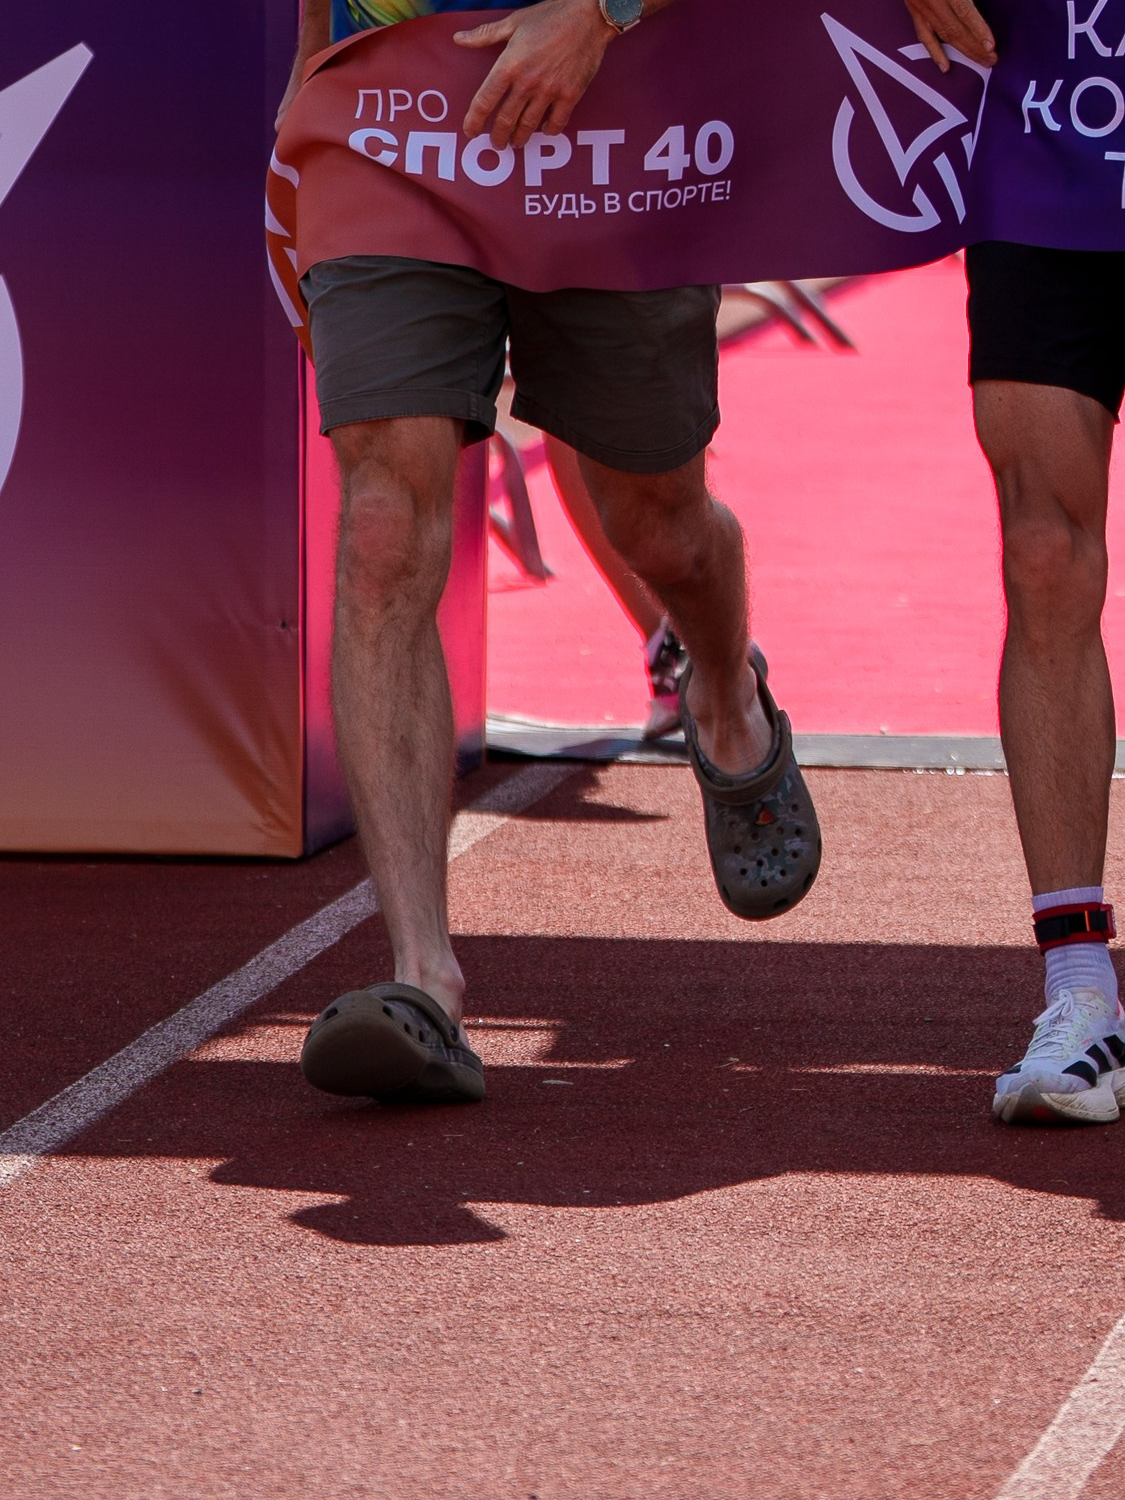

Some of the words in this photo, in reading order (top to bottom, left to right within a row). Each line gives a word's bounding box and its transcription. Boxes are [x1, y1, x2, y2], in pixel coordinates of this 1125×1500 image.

[354, 88, 449, 123] ПРО
[348, 127, 626, 188] СПОРТ
[643, 120, 735, 182] 40
[524, 193, 597, 219] БУДЬ
[603, 192, 621, 214] В
[628, 180, 732, 212] СПОРТЕ!
